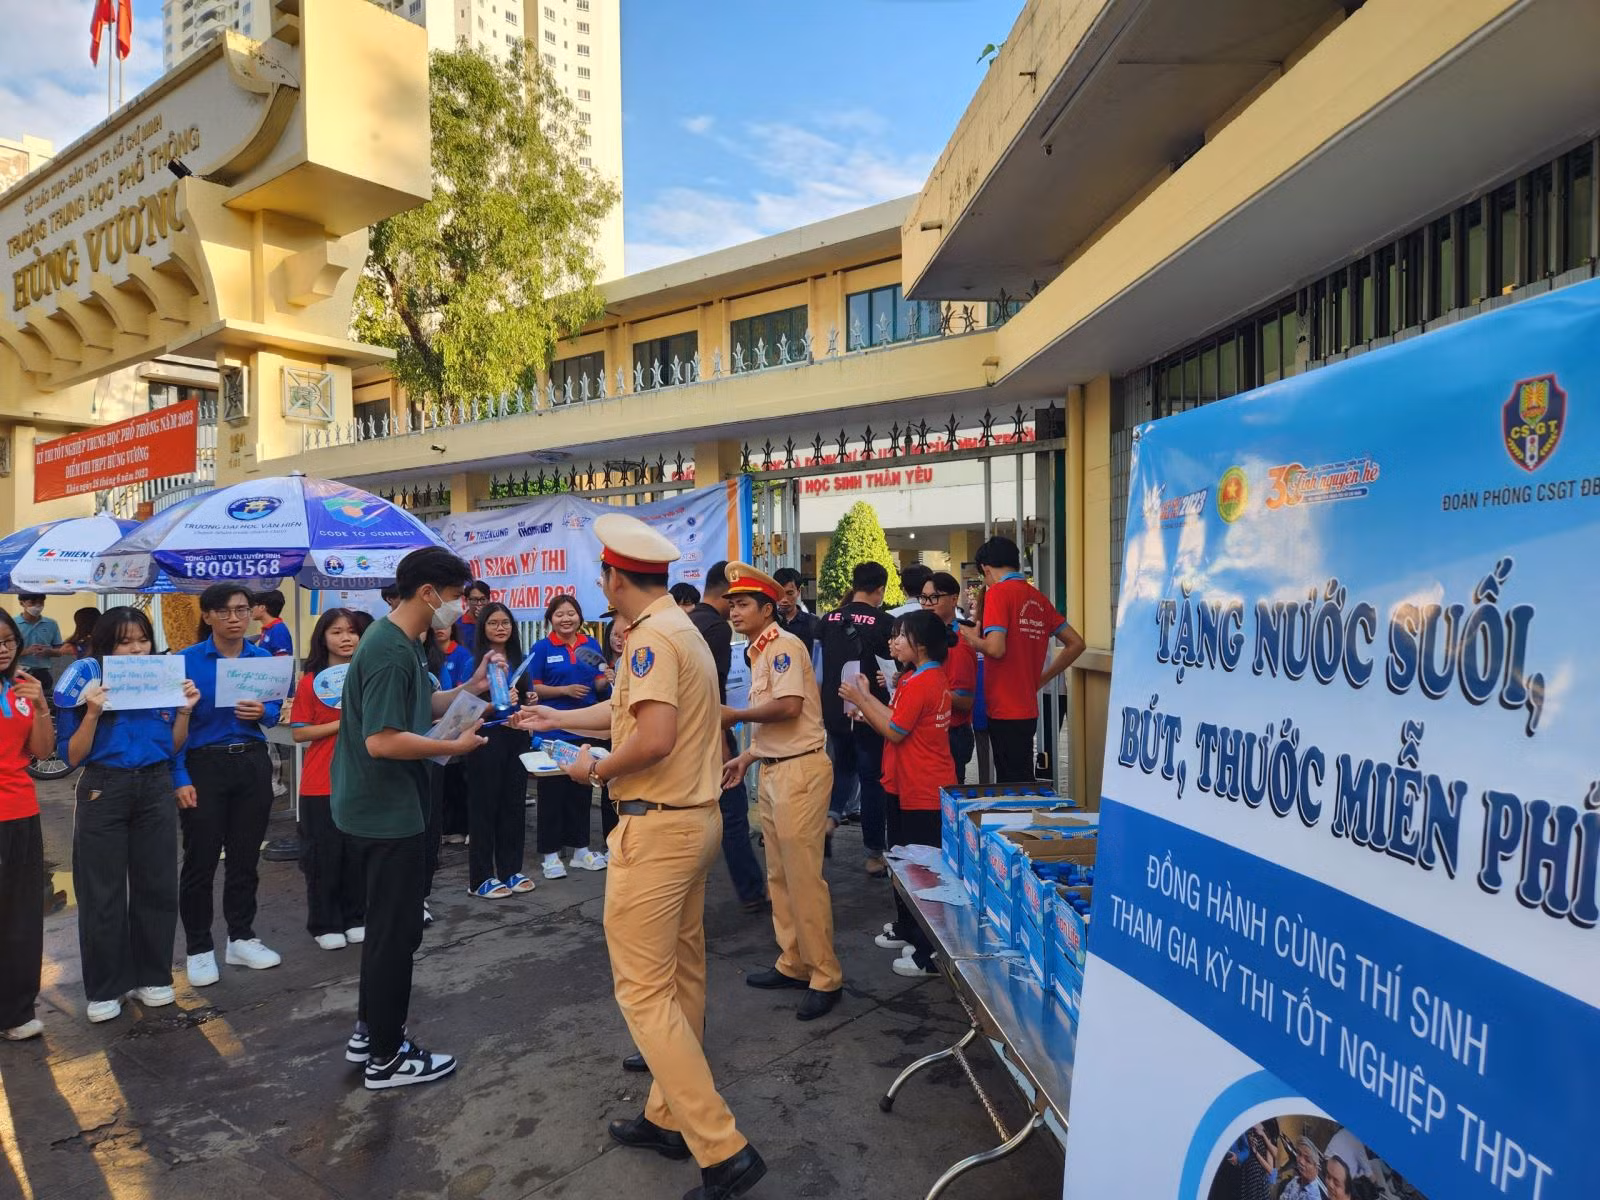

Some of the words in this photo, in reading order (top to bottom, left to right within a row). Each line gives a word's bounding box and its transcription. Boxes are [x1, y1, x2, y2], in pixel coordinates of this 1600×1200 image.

[48, 193, 85, 233] TRUNG
[88, 176, 114, 212] HỌC
[118, 146, 145, 194] PHỔ
[13, 246, 80, 312] HÙNG
[87, 433, 106, 451] TRUNG
[160, 412, 177, 432] NĂM
[1510, 420, 1558, 439] CSGT
[805, 479, 831, 496] HỌC
[834, 474, 863, 491] SINH
[866, 467, 902, 488] THÂN
[905, 463, 933, 484] YÊU
[1442, 489, 1478, 511] ĐOÀN
[1482, 483, 1532, 508] PHÒNG
[1536, 480, 1577, 502] CSGT
[1180, 490, 1208, 516] 2023
[319, 530, 349, 538] CODE
[351, 530, 366, 538] TO
[370, 530, 416, 538] CONNECT
[183, 559, 281, 577] 18001568
[484, 556, 518, 577] SINH
[540, 549, 567, 573] THI
[508, 582, 541, 609] NĂM
[1155, 579, 1245, 684] TẶNG
[1252, 577, 1378, 689] NƯỚC
[1385, 555, 1546, 737] SUỐI,
[1118, 693, 1187, 800] BÚT,
[1195, 717, 1326, 828] THƯỚC
[1331, 720, 1468, 879] MIỄN
[1476, 780, 1600, 929] PHÍ
[1147, 849, 1201, 912] ĐỒNG
[1206, 880, 1267, 947] HÀNH
[1274, 913, 1346, 991] CÙNG
[1355, 954, 1403, 1023] THÍ
[1410, 986, 1488, 1076] SINH
[1110, 894, 1163, 952] THAM
[1167, 926, 1199, 977] GIA
[1206, 946, 1233, 993] KỲ
[1238, 964, 1274, 1023] THI
[1282, 987, 1333, 1056] TỐT
[1339, 1025, 1447, 1135] NGHIỆP
[1457, 1103, 1553, 1200] THPT
